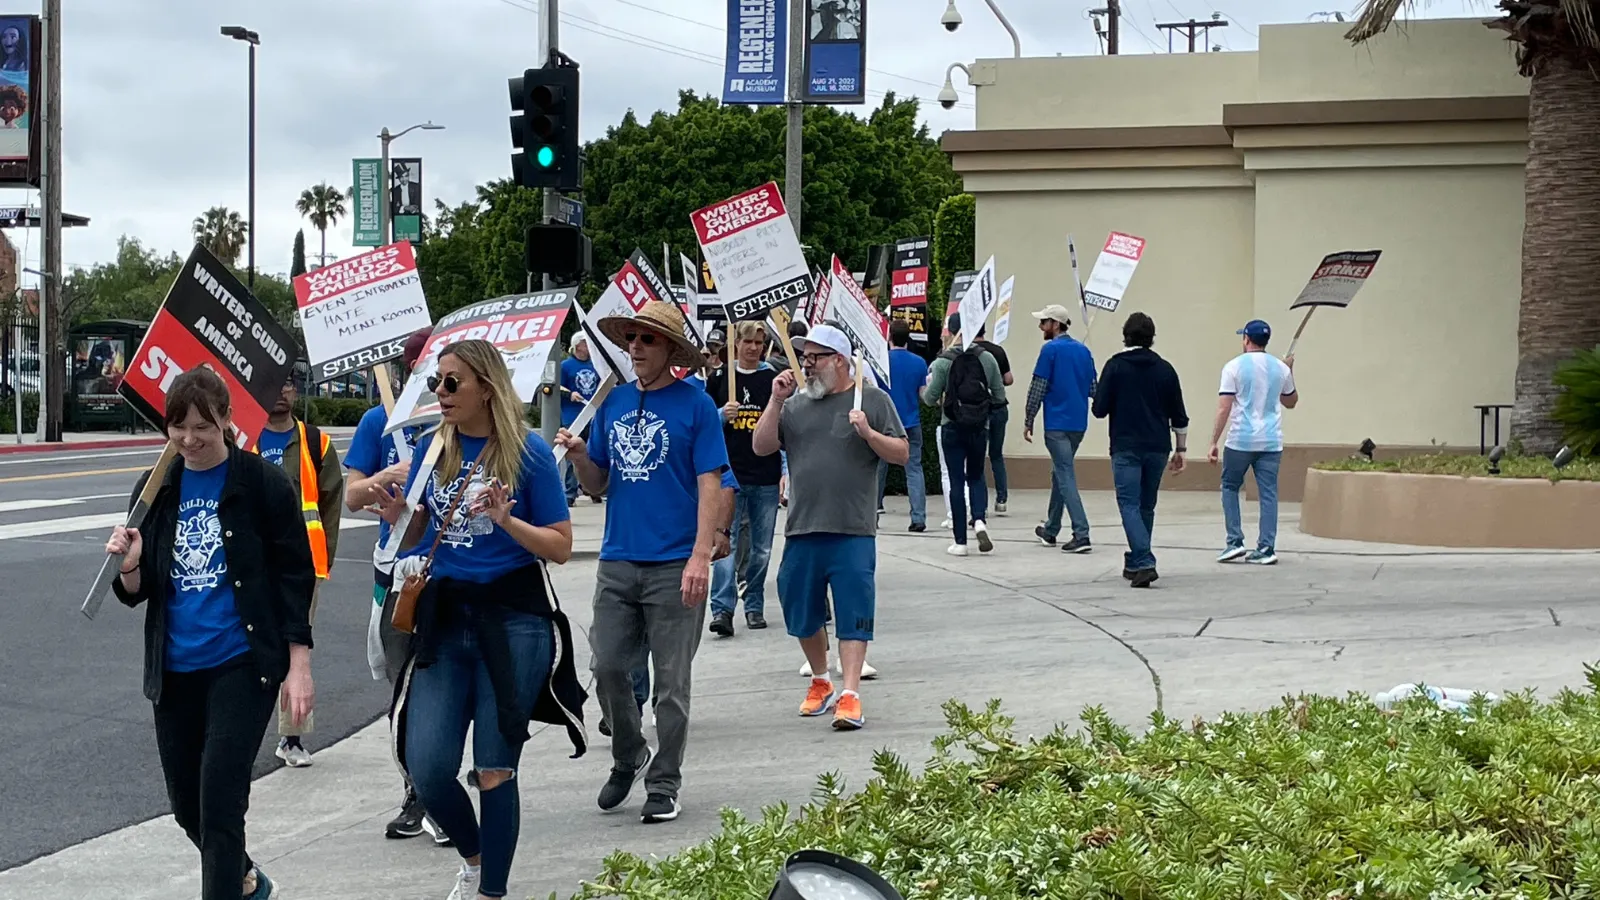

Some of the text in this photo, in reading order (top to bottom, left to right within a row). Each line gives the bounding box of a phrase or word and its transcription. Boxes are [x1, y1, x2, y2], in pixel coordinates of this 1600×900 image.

[764, 40, 775, 73] BLACK
[359, 163, 374, 231] REGENERATION
[700, 188, 770, 221] WRITERS
[705, 200, 769, 229] GUILD OF
[706, 206, 778, 240] AMERICA
[305, 247, 399, 284] WRITERS
[307, 262, 406, 302] AMERICA
[309, 258, 396, 291] GUILD OF
[636, 255, 676, 308] WRITER
[1314, 264, 1371, 279] STRIKE!
[733, 279, 808, 319] STRIKE
[892, 281, 926, 299] STRIKE!
[1085, 292, 1117, 310] STRIKE
[192, 262, 253, 328] WRITERS
[251, 319, 288, 366] GUILD
[304, 297, 346, 319] EVEN
[324, 307, 364, 329] HATE
[381, 304, 423, 323] ROOMS
[442, 293, 567, 328] WRITERS GUILD
[487, 313, 505, 323] ON
[226, 321, 244, 341] OF
[426, 315, 557, 357] STRIKE!
[194, 316, 254, 382] AMERICA
[322, 336, 410, 378] STRIK
[646, 411, 659, 421] OF
[733, 418, 757, 430] WG
[261, 448, 284, 458] GUILD
[178, 498, 205, 514] UILD
